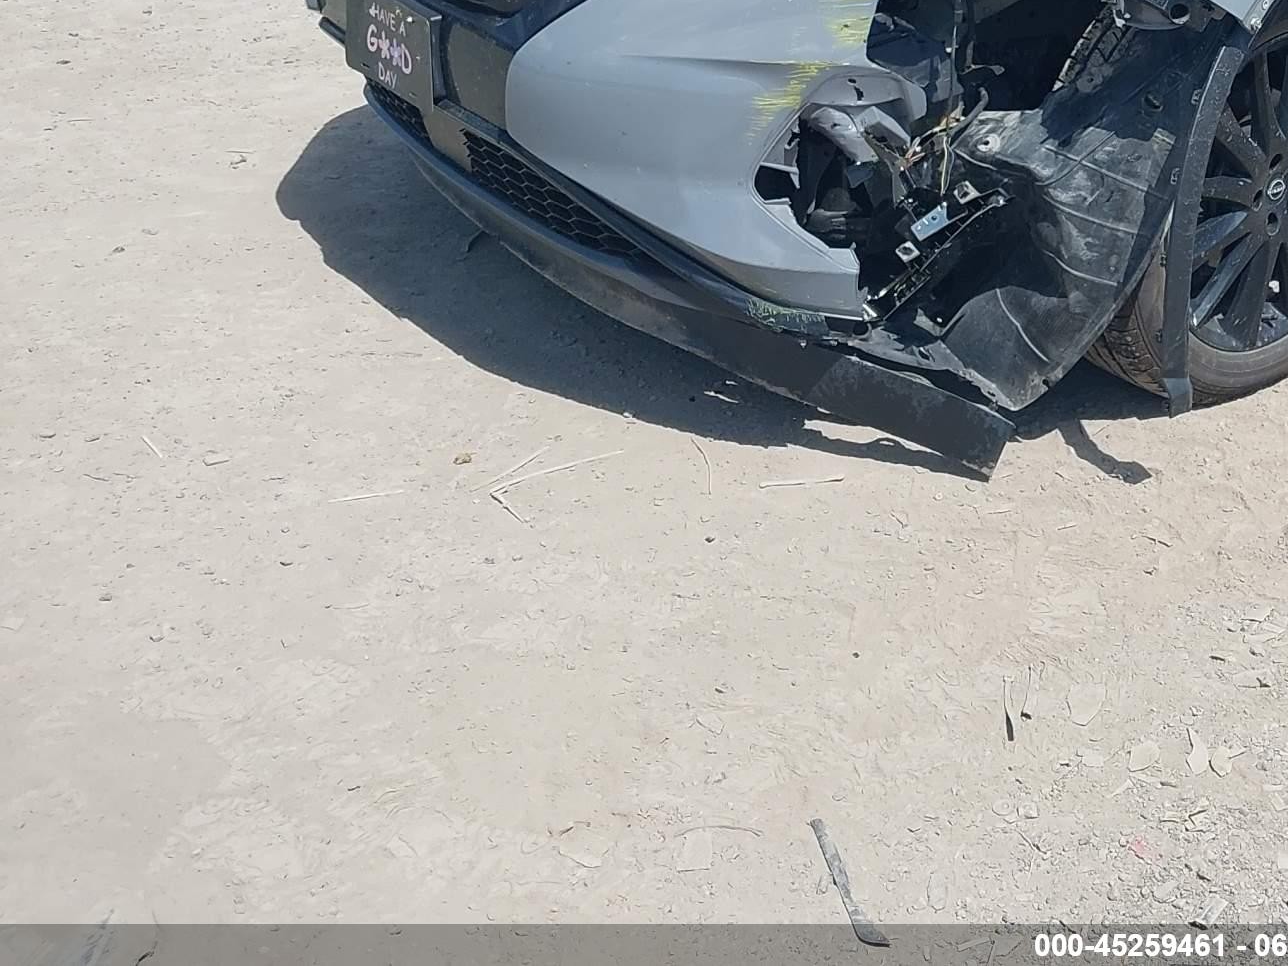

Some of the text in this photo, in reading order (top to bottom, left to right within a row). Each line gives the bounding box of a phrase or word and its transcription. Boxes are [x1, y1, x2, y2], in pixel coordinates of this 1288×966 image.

[368, 2, 406, 37] HAVE A
[378, 61, 397, 89] DAY
